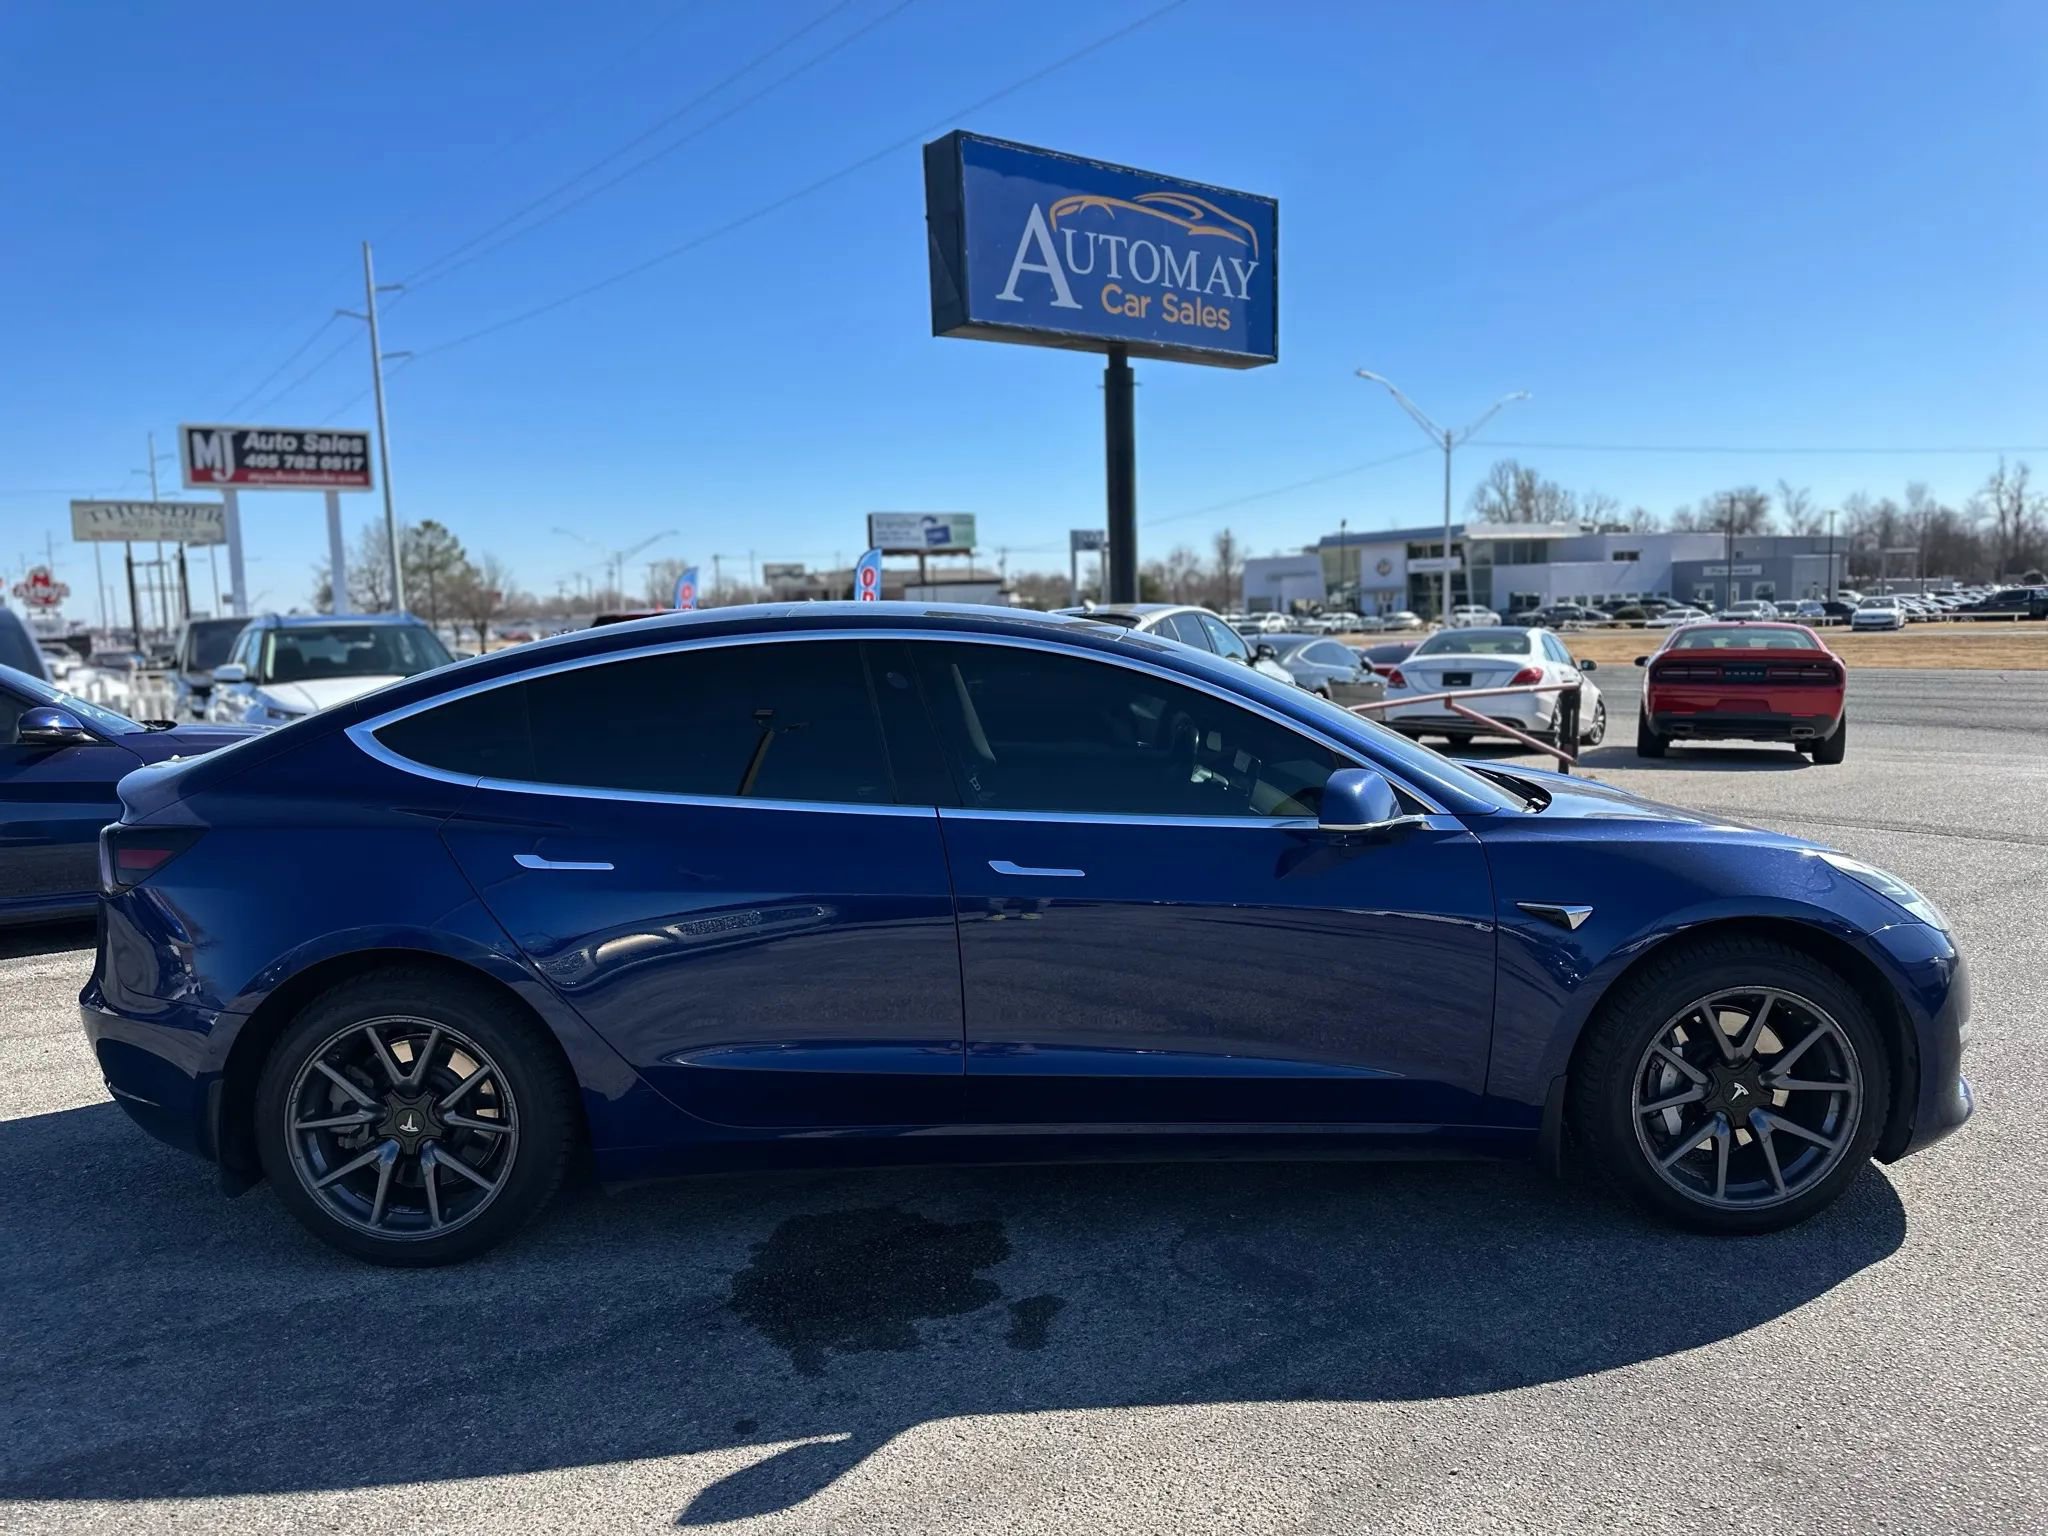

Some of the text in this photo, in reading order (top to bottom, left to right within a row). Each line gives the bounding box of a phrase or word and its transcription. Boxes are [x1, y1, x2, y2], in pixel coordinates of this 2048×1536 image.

[995, 203, 1259, 309] AUTOMAY
[1101, 283, 1231, 331] Car Sales
[191, 430, 238, 482] MJ
[242, 431, 364, 455] Auto Sales
[244, 453, 280, 469] 405
[86, 503, 224, 524] THUNDER
